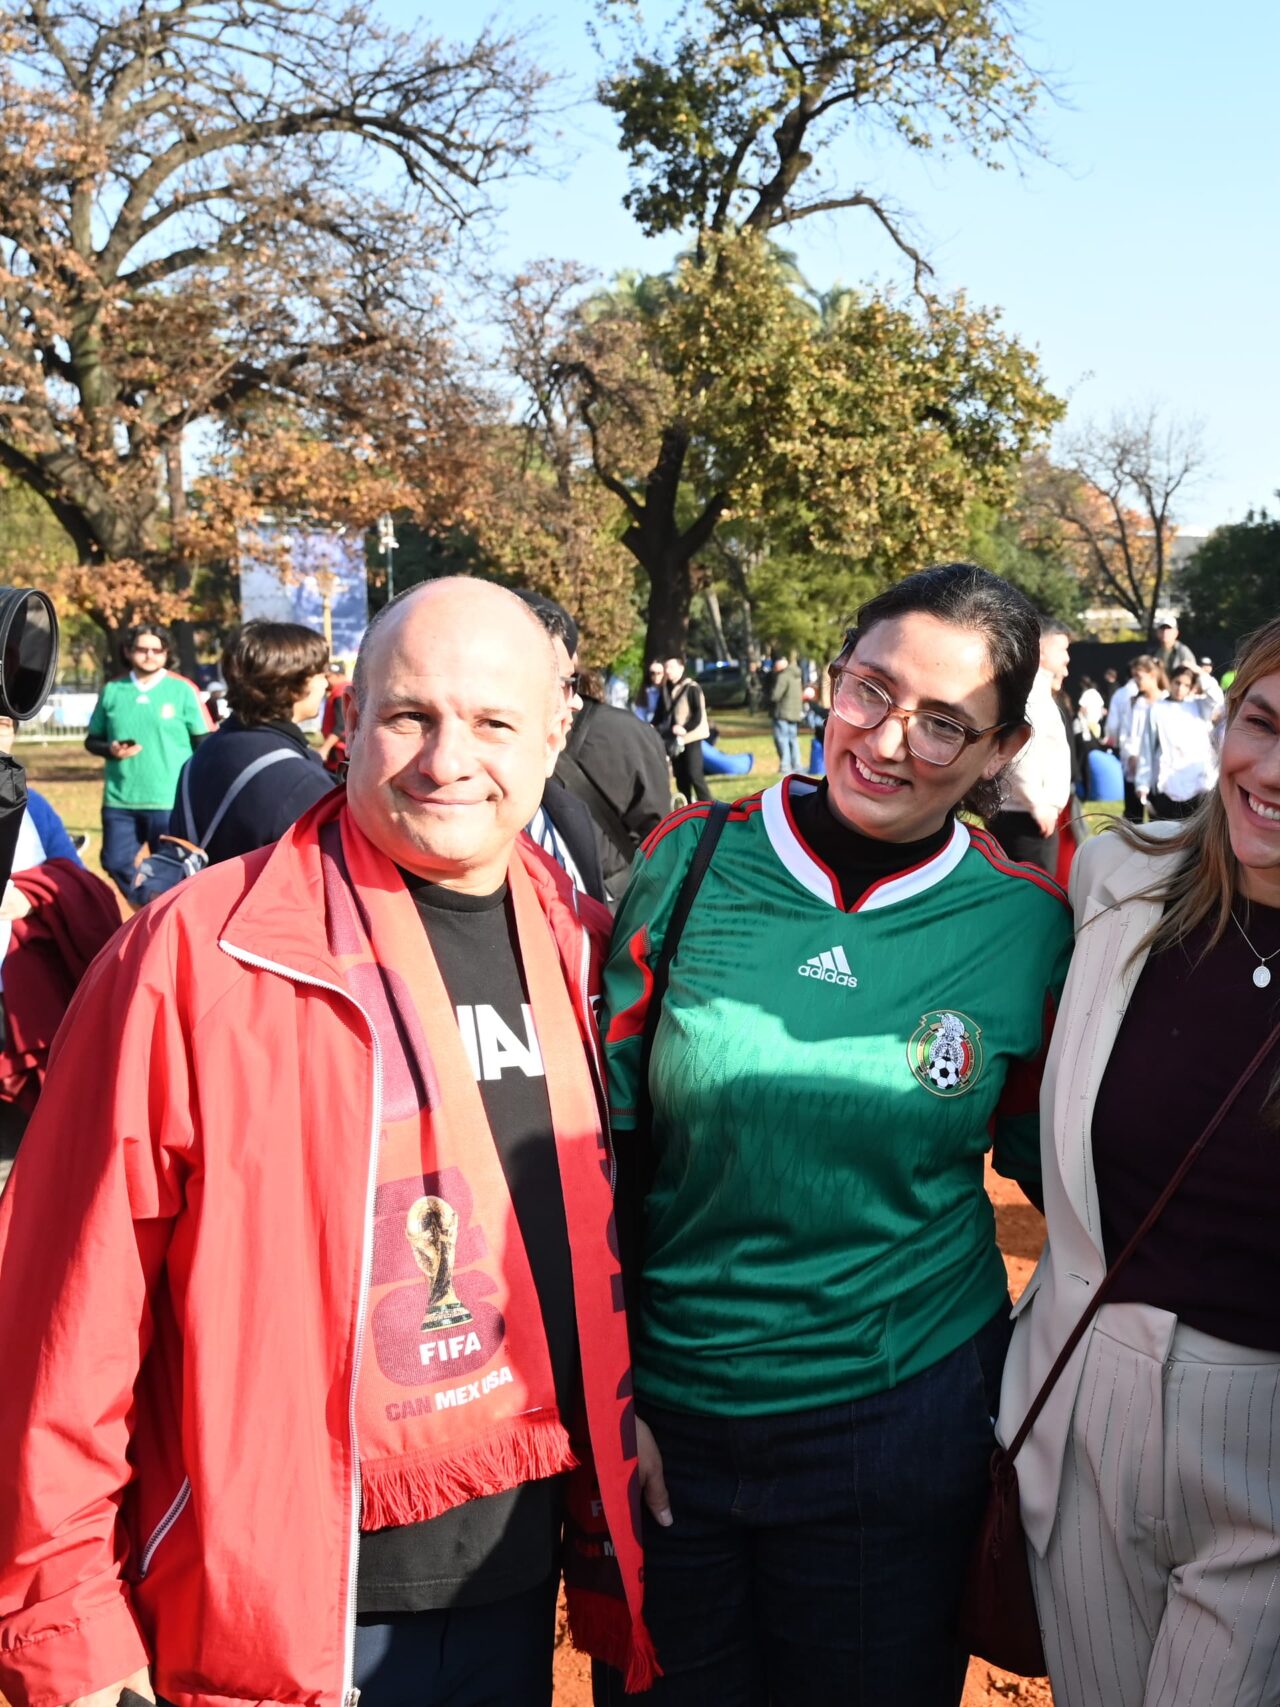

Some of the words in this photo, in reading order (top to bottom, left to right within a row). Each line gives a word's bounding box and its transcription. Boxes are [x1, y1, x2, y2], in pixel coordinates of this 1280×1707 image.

[798, 965, 858, 988] adidas
[419, 1331, 482, 1366] FIFA
[385, 1396, 432, 1421] CAN
[435, 1381, 480, 1410] MEX
